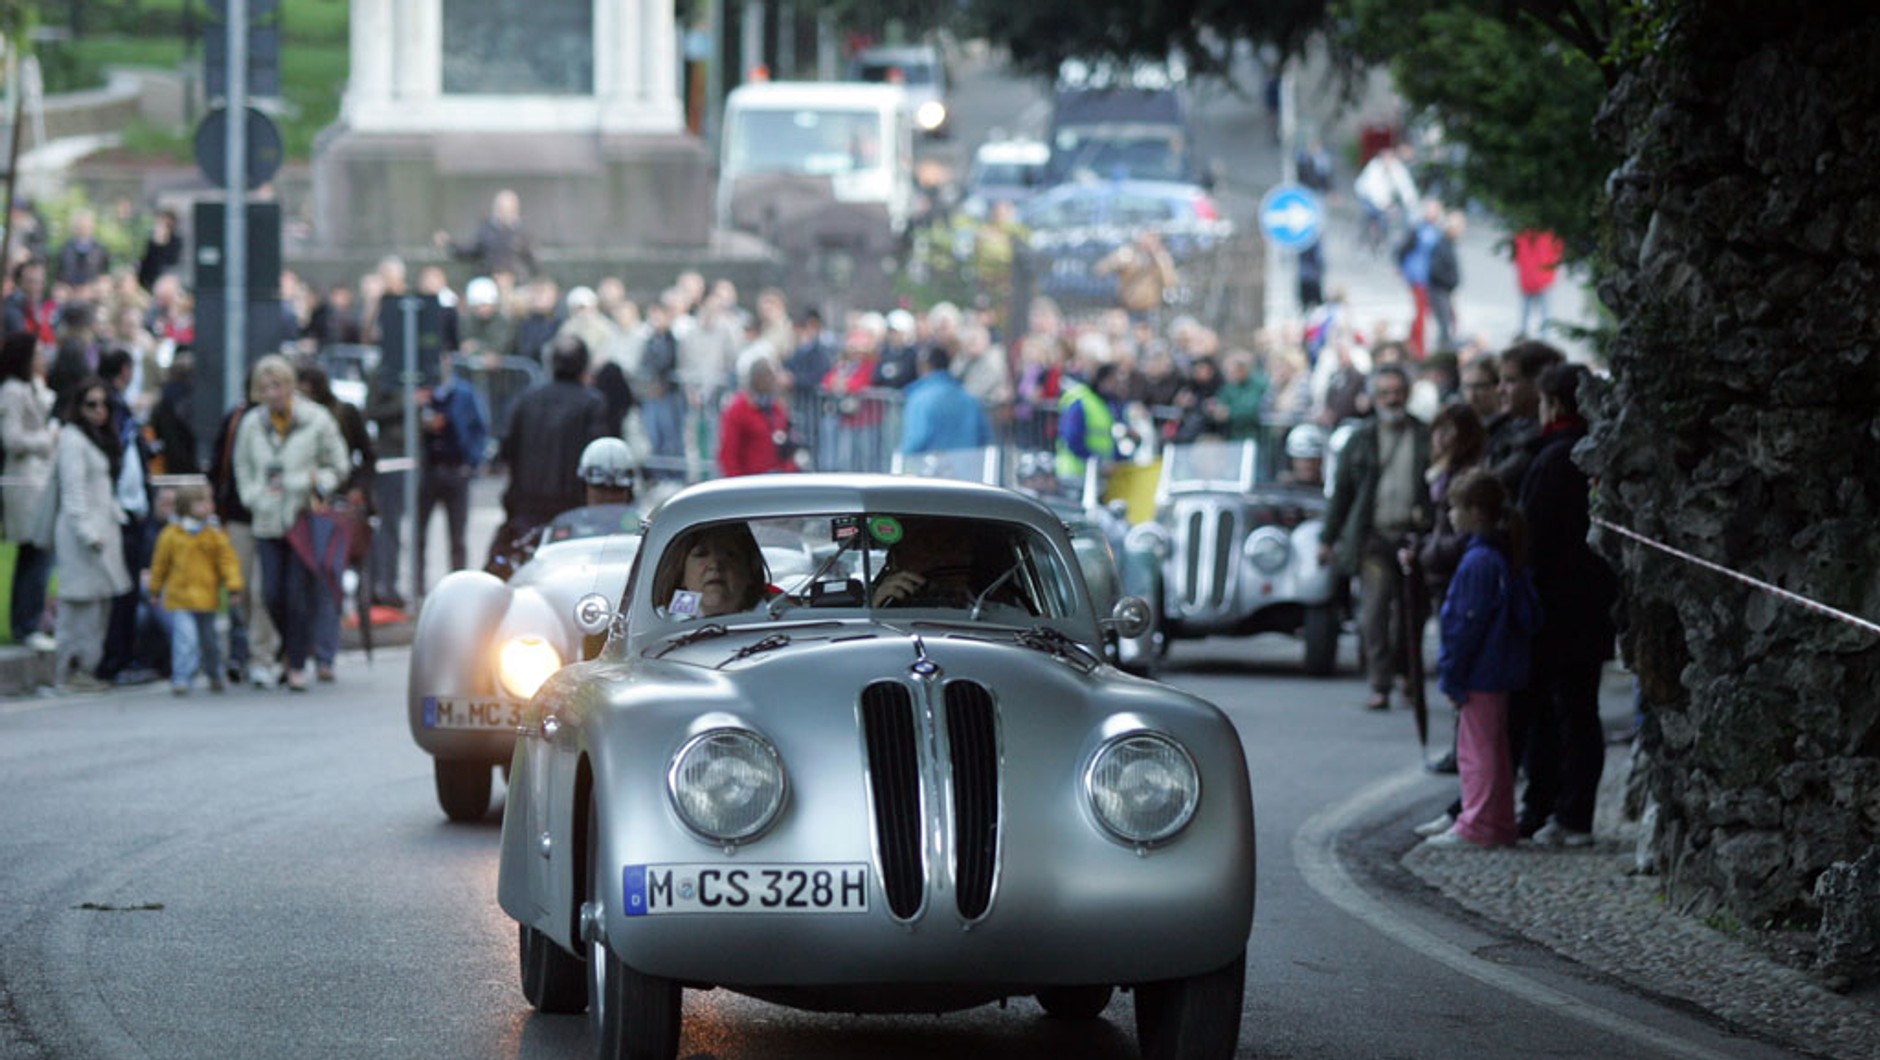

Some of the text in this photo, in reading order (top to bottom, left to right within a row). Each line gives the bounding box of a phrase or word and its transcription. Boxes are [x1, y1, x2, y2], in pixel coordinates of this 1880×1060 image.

[437, 702, 453, 725] M
[468, 702, 500, 725] MC
[649, 870, 673, 907] M
[698, 870, 749, 907] CS
[631, 894, 641, 907] D
